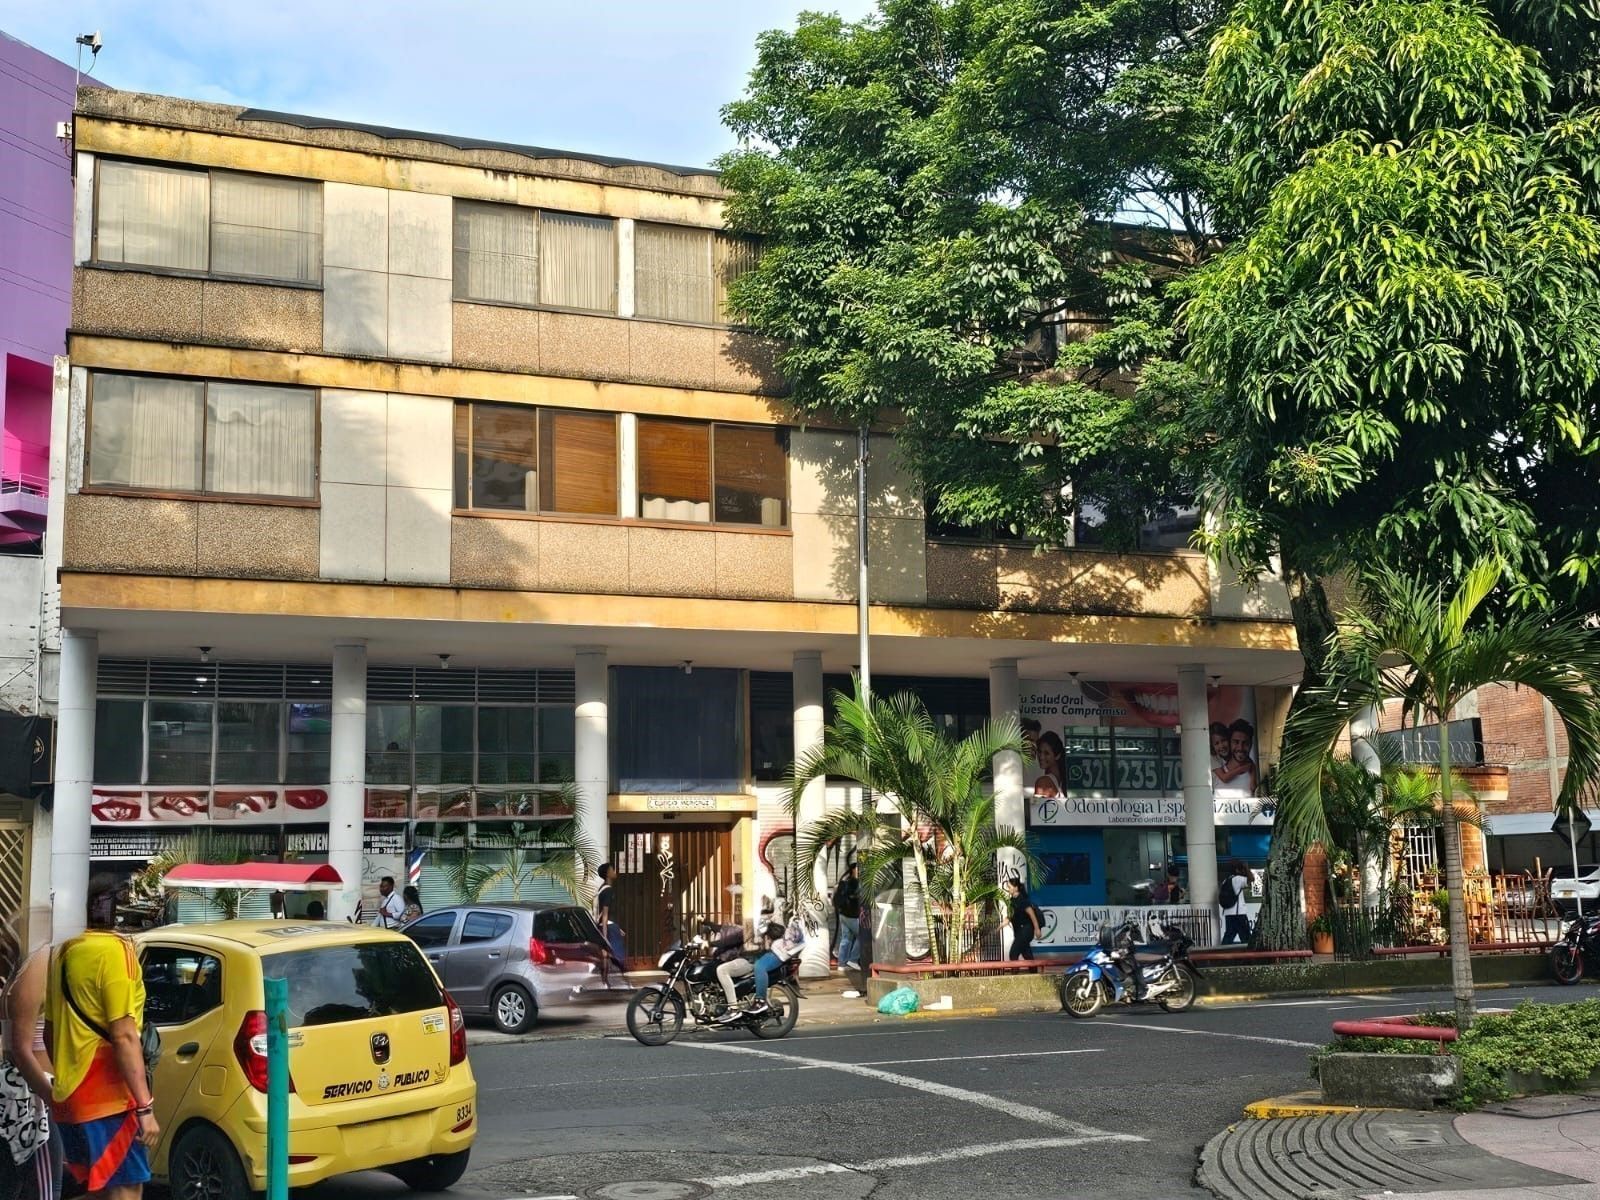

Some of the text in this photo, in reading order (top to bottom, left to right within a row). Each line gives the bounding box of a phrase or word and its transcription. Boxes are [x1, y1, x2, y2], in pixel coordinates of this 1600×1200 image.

[1061, 705, 1128, 718] Compromiso
[1081, 759, 1112, 788] 321
[1117, 760, 1158, 789] 235
[1144, 815, 1163, 824] dental
[323, 1069, 430, 1099] SERVICIO PUBLICO
[456, 1103, 473, 1123] 8334
